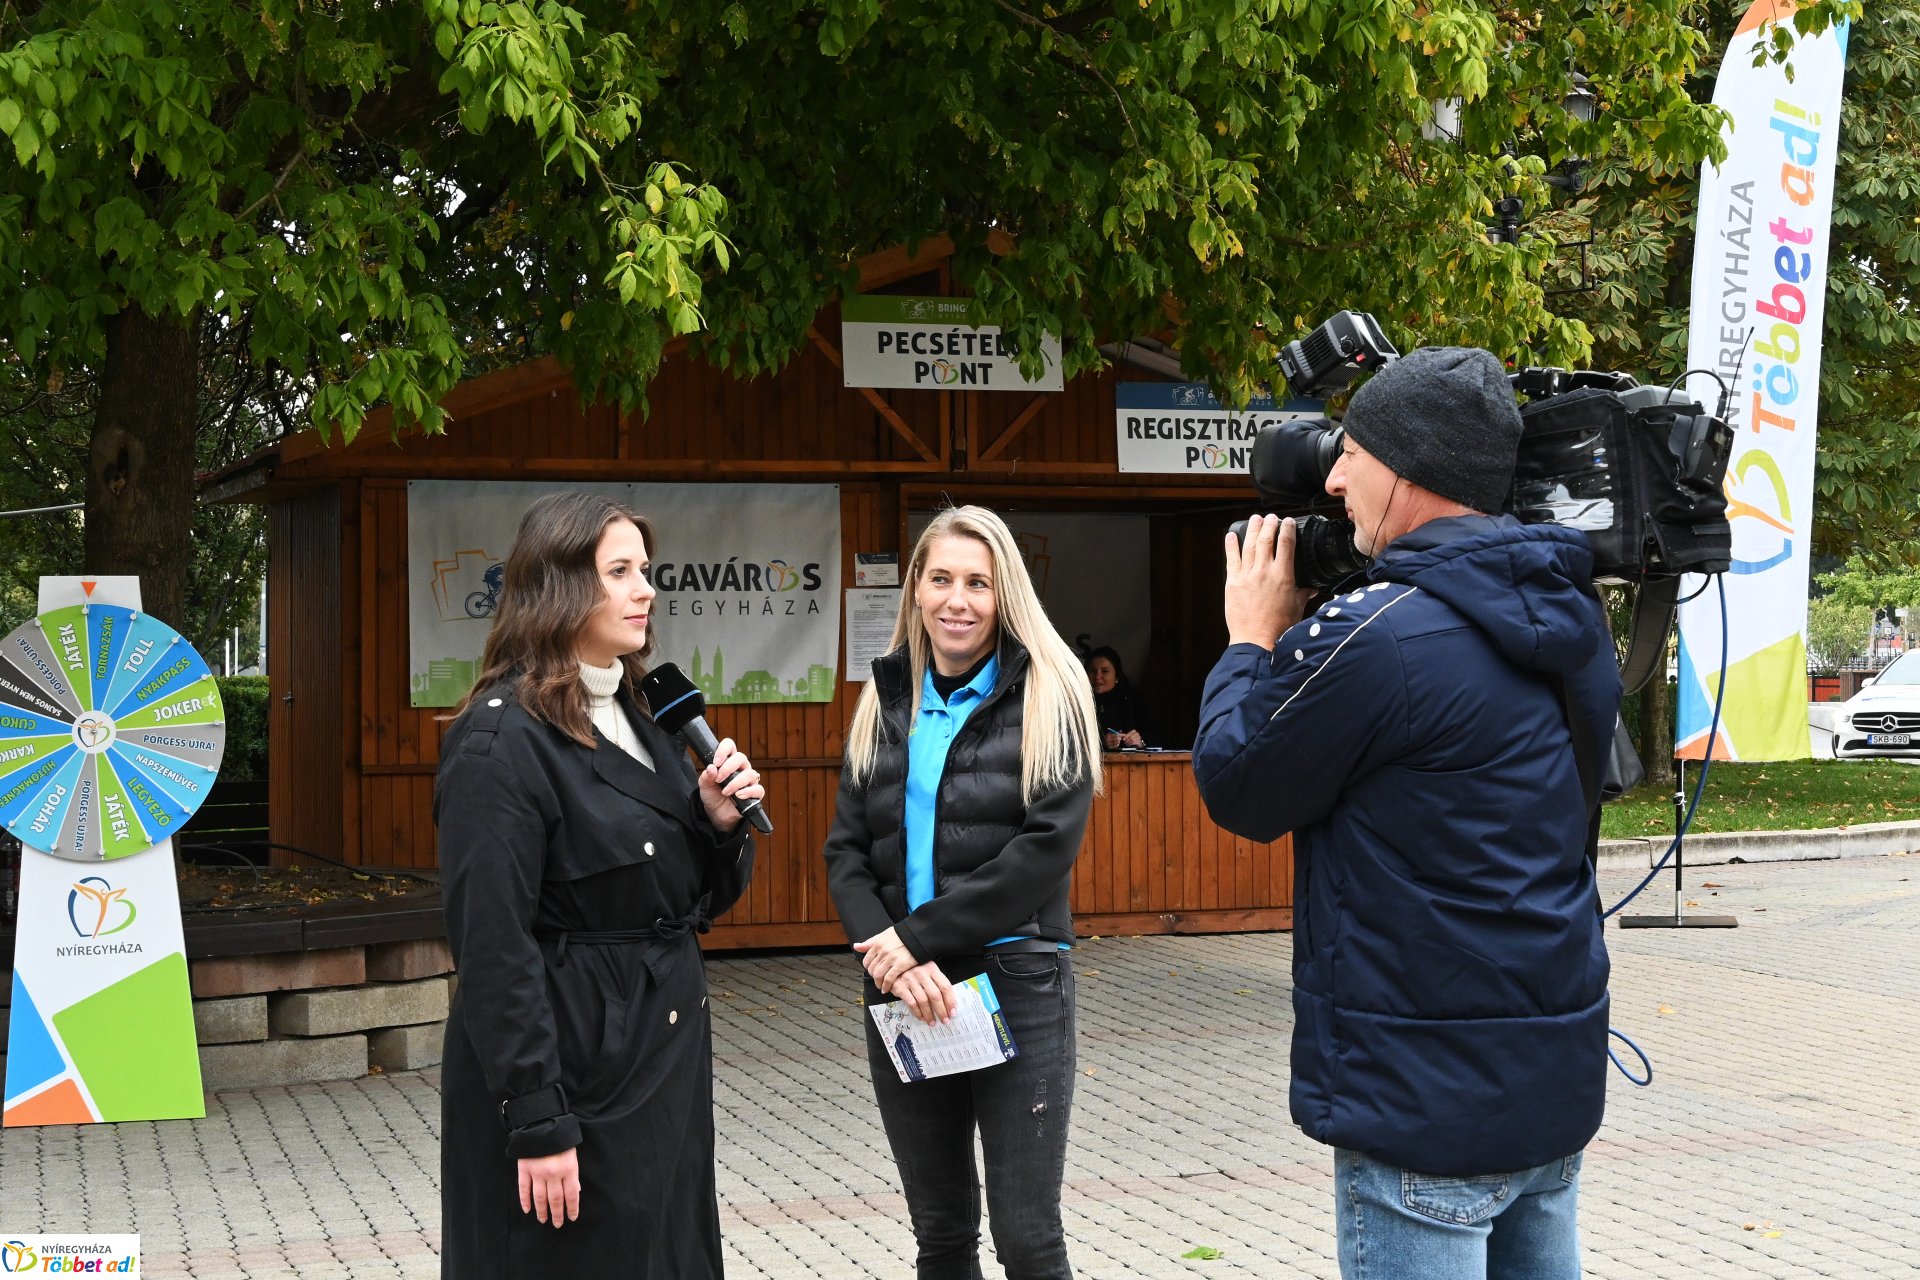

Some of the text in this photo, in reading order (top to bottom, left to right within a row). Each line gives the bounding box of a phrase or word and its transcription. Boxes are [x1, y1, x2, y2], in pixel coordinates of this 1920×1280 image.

[1751, 98, 1822, 434] Többet ad!
[938, 303, 968, 313] BRING
[878, 328, 1019, 357] PECSÉTEL
[915, 359, 993, 384] PONT
[1127, 414, 1298, 441] REGISZTRÁ
[1186, 444, 1253, 469] PON
[649, 557, 822, 592] GAVÁROS
[59, 623, 84, 671] JÁTÉK
[96, 616, 114, 680] TORNAZSÁK
[123, 639, 155, 673] TOLL
[16, 635, 66, 696] PÖRGESS ÚJRA!
[136, 657, 191, 701] NYAKPASS
[0, 677, 62, 717] SAJNOS NEM NYER
[153, 698, 203, 722] JOKER
[0, 744, 35, 765] KARK
[143, 734, 216, 751] PÖRGESS ÚJRA!
[1873, 735, 1908, 743] SKB-690
[29, 784, 67, 833] POHÁR
[74, 780, 92, 852] PÖRGESS ÚJRA!
[104, 794, 130, 842] JÁTÉK
[127, 777, 174, 828] LEGYEZŐ
[56, 942, 143, 957] NYÍREGYHÁZA
